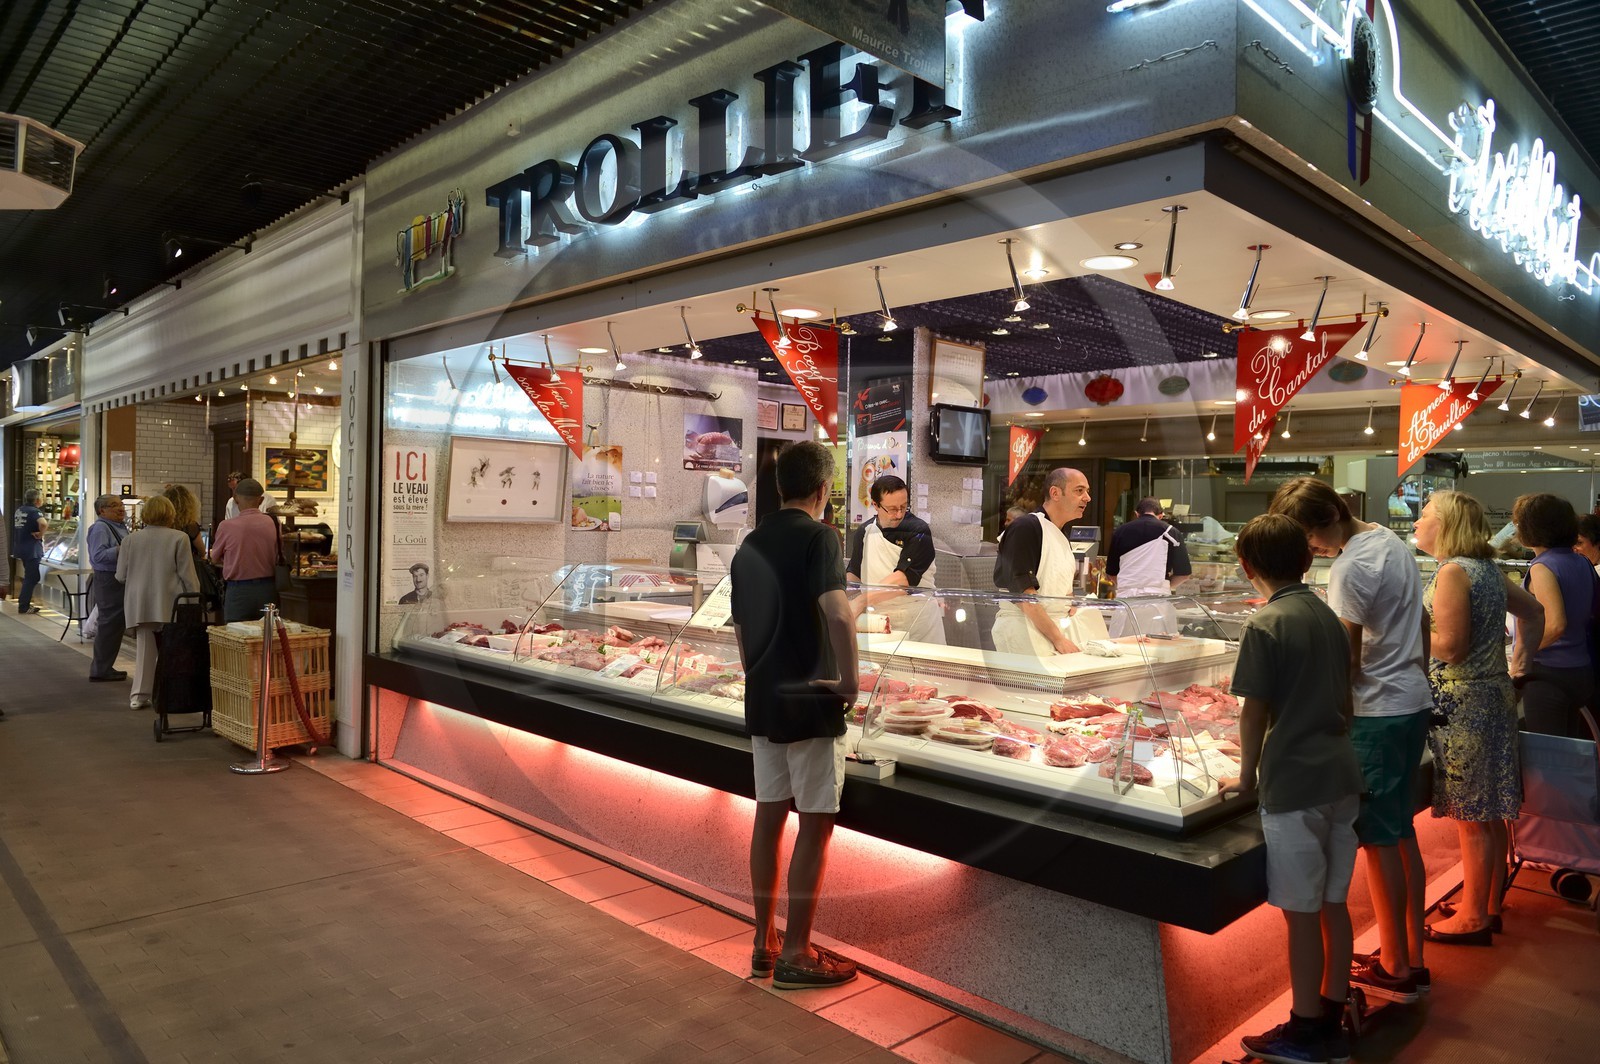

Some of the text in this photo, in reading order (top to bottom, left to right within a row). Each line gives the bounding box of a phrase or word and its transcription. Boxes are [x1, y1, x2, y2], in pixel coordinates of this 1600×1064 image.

[852, 26, 899, 58] Maurice
[1250, 335, 1294, 384] Porc
[1258, 331, 1329, 407] Cantal
[540, 379, 573, 409] Veau
[786, 360, 825, 411] Salers
[517, 376, 581, 445] sous la Mère
[1248, 405, 1268, 433] du
[1401, 384, 1455, 447] Agneau
[1407, 398, 1472, 463] de Pauillac
[345, 369, 357, 569] JOCTEUR
[395, 451, 427, 482] ICI
[393, 482, 429, 495] LE VEAU
[393, 494, 429, 504] est élevé
[393, 534, 428, 544] Le Goût
